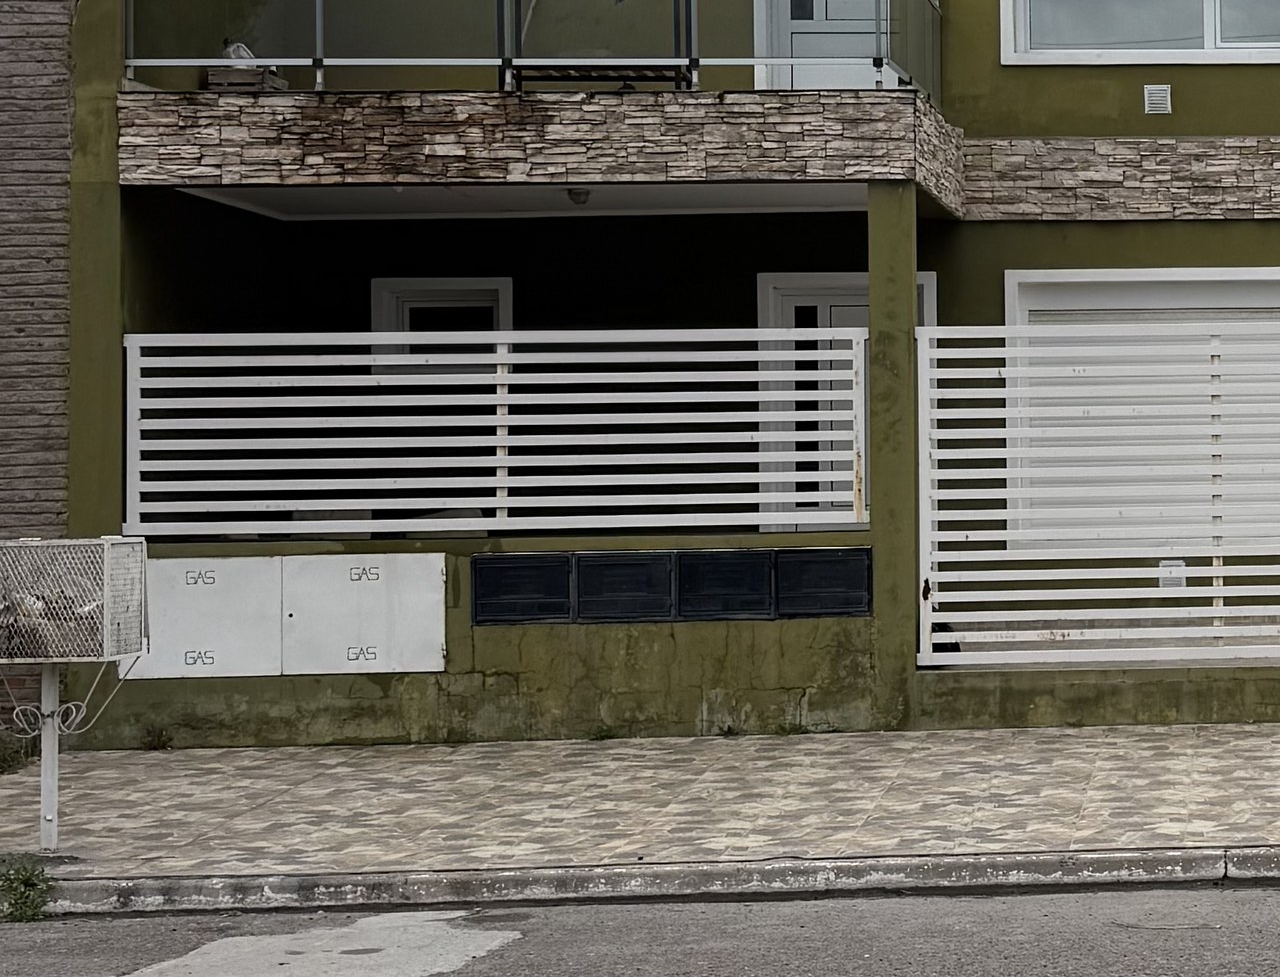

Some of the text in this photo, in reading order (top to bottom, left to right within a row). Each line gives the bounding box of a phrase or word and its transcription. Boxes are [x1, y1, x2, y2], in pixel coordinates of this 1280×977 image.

[185, 570, 216, 585] GAS
[349, 566, 380, 582] GAS
[184, 650, 215, 666] GAS
[346, 646, 377, 661] GAS
